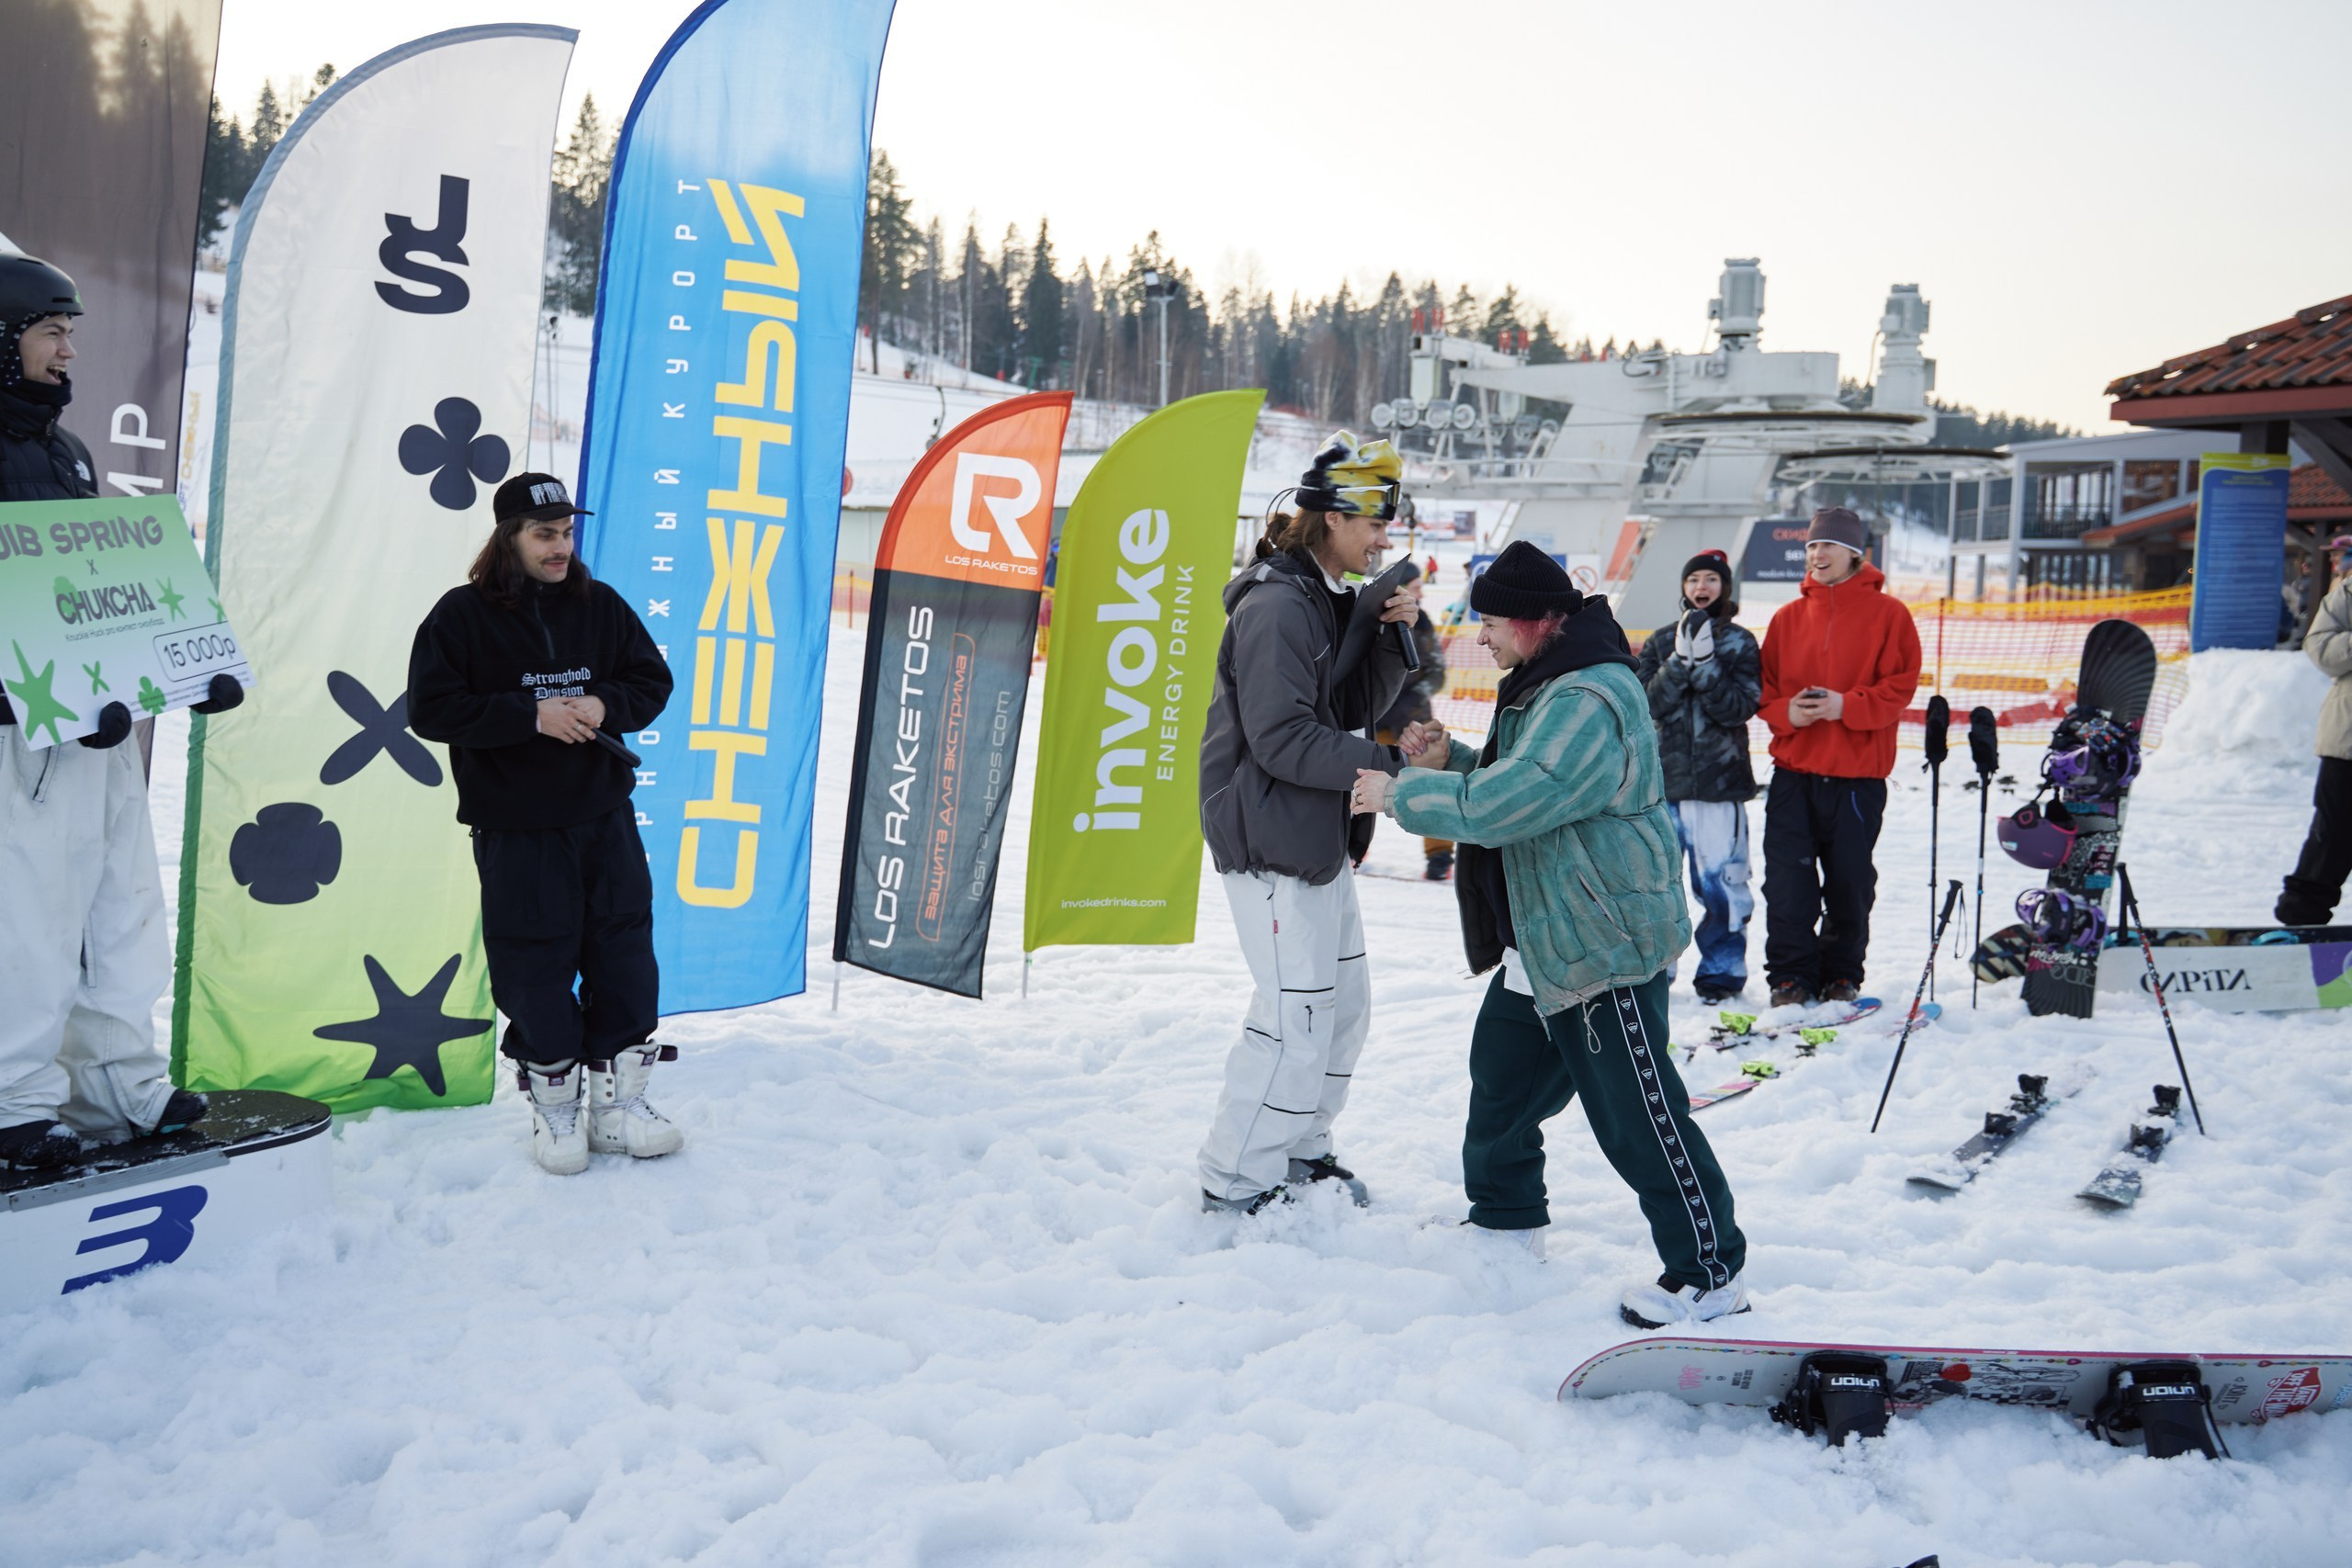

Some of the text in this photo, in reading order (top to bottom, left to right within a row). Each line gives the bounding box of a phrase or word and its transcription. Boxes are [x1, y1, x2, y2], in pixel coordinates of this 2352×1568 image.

[662, 178, 701, 418] КУРОРТ
[50, 515, 164, 555] SPRING
[676, 177, 805, 908] СНЕЖНЫЙ
[944, 555, 1038, 576] LOS RAKETOS
[56, 581, 156, 626] CHUKCHA
[164, 642, 187, 669] 15
[521, 667, 592, 687] Stronghold
[1073, 508, 1170, 833] invoke
[1156, 565, 1195, 781] ENERGY DRINK
[868, 606, 933, 949] LOS RAKETOS
[967, 691, 1011, 902] losraketos.com
[924, 829, 949, 920] защита
[1061, 897, 1167, 908] invokedrinks.com
